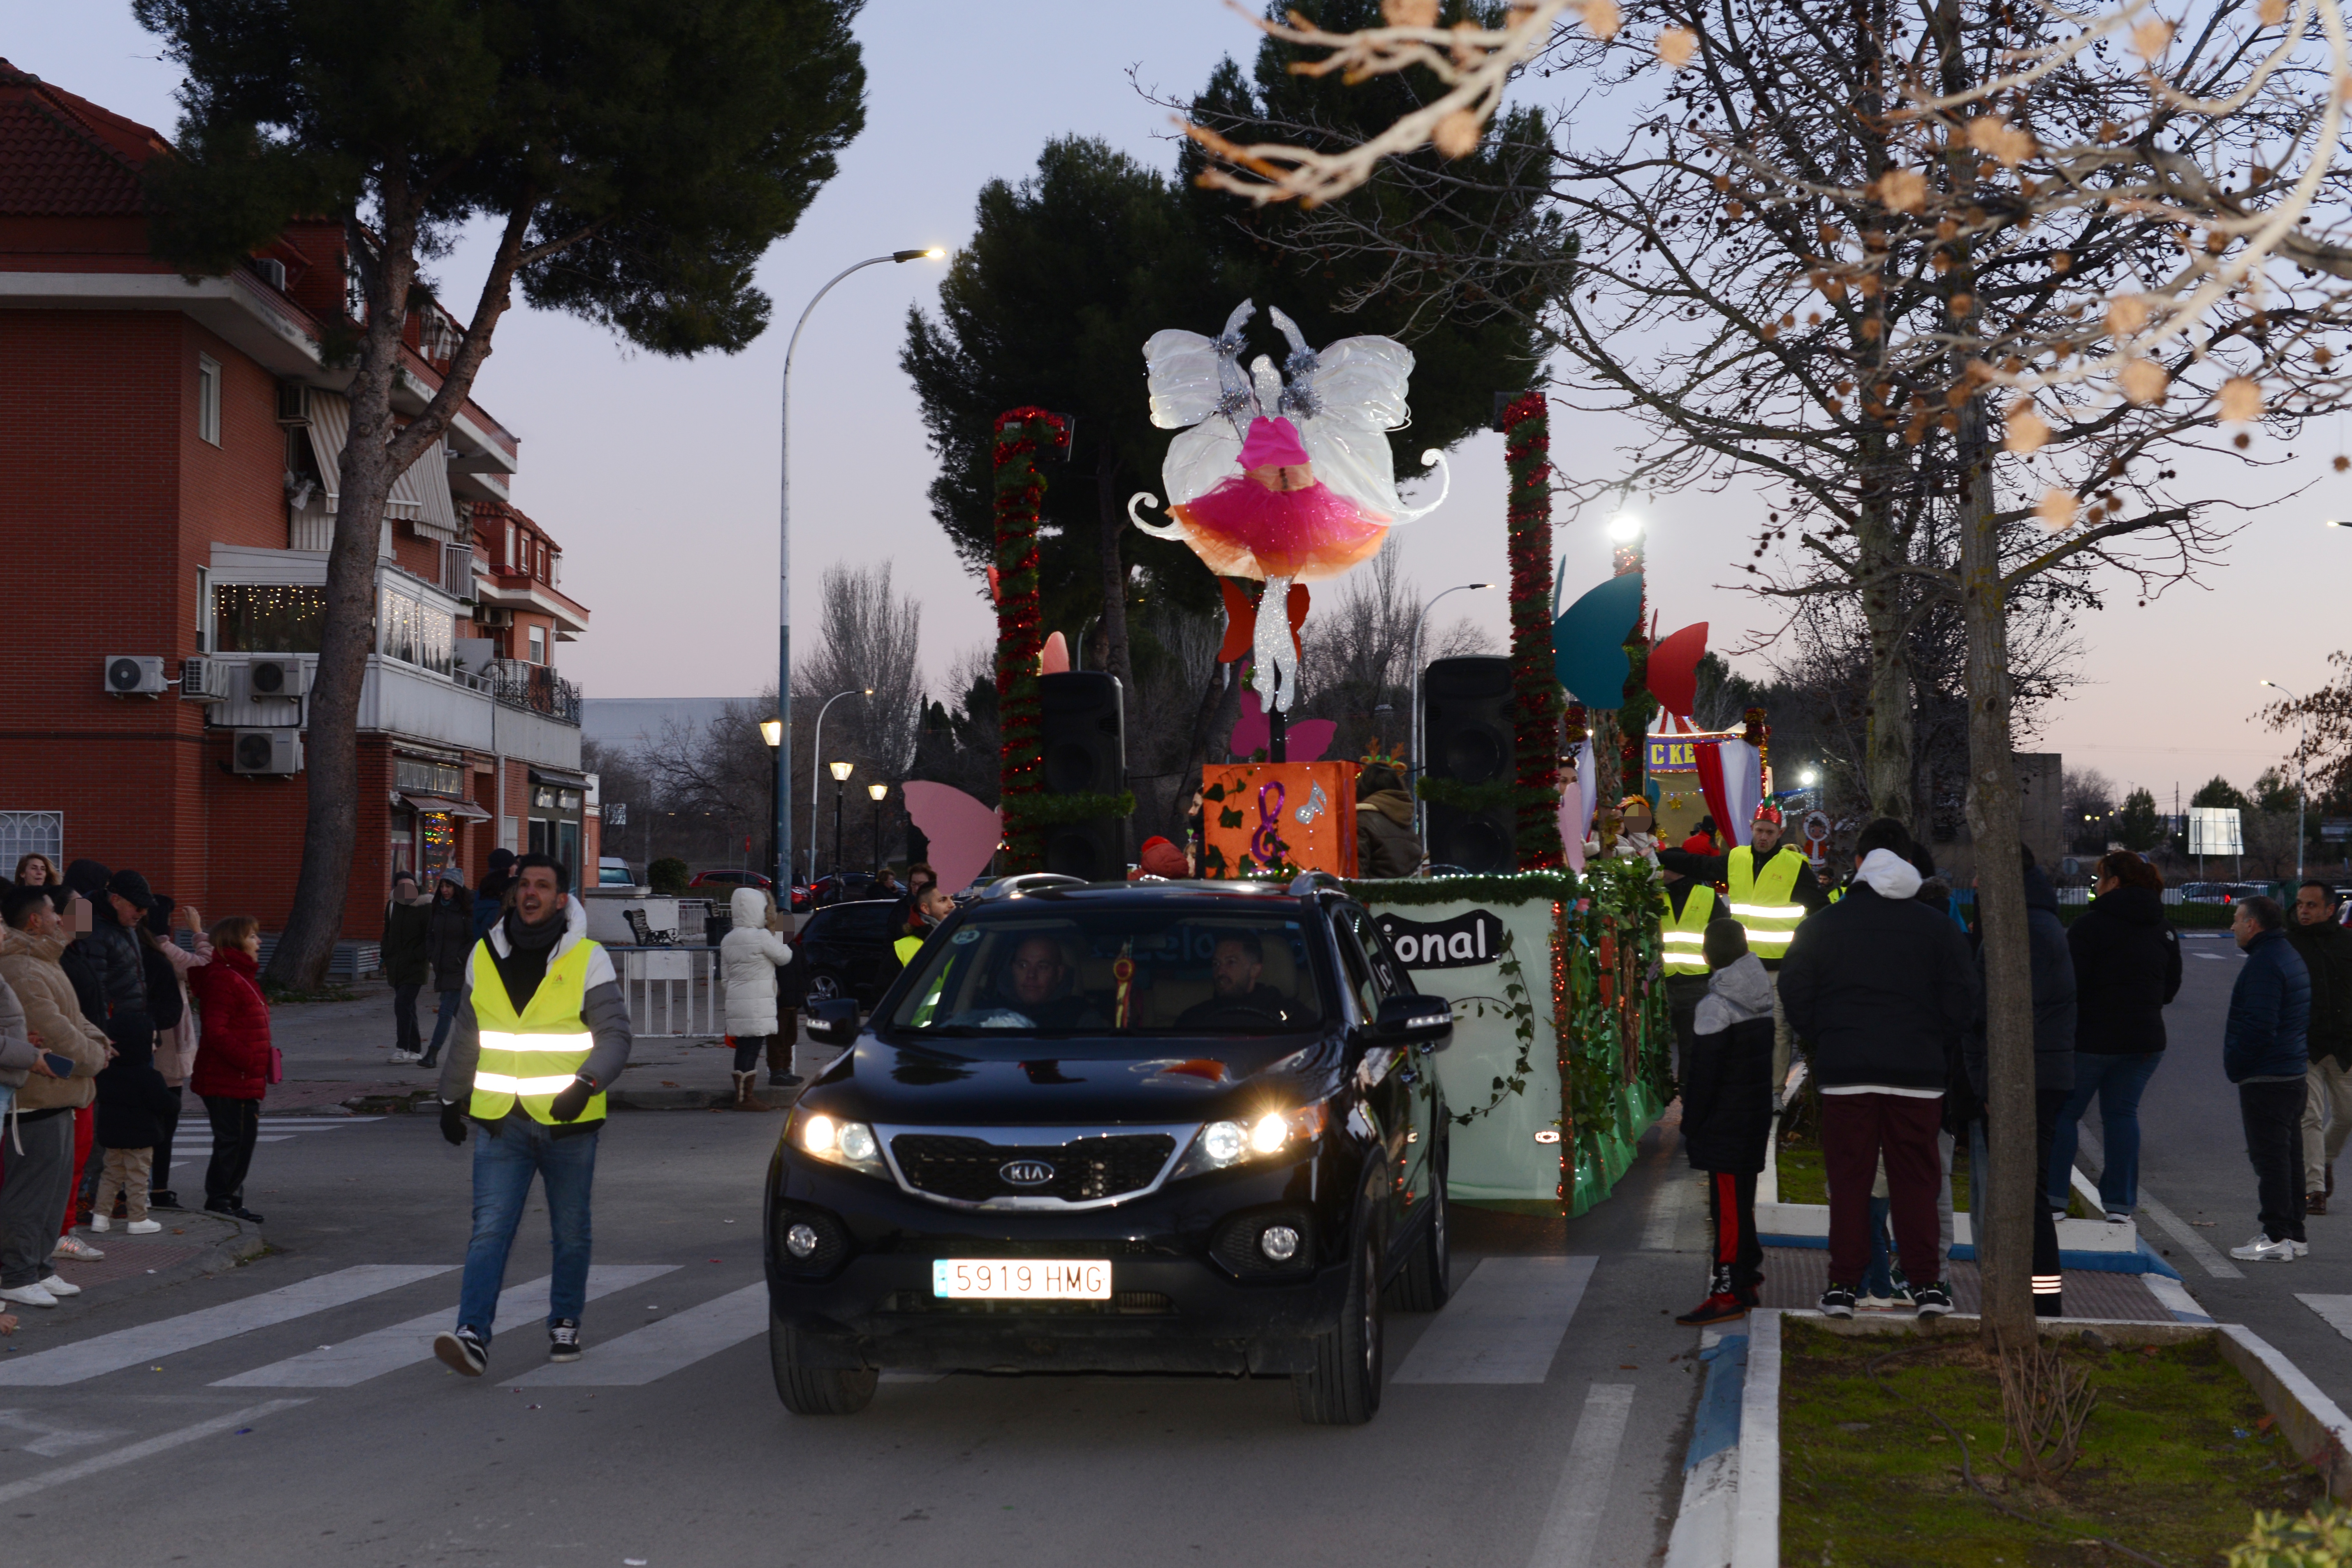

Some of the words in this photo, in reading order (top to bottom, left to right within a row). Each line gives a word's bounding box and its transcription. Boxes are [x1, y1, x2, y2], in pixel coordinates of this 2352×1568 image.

[1011, 1165, 1044, 1179] KIA
[957, 1265, 1031, 1291] 5919
[1046, 1265, 1101, 1292] HMG
